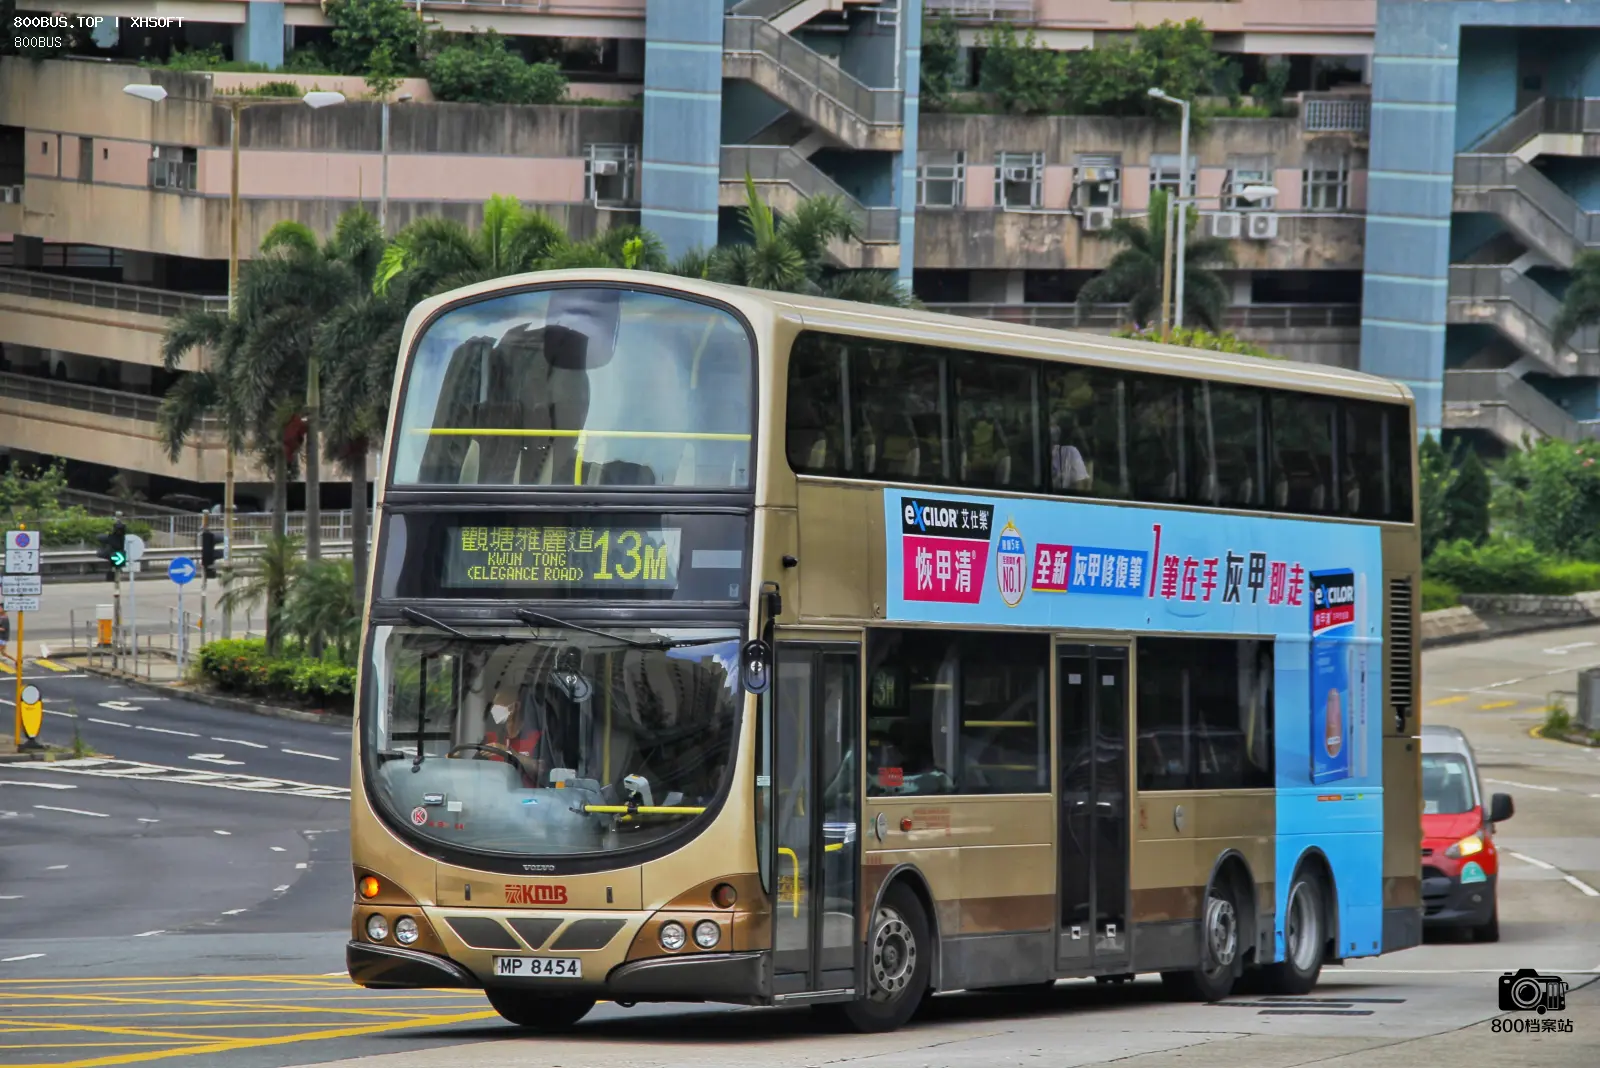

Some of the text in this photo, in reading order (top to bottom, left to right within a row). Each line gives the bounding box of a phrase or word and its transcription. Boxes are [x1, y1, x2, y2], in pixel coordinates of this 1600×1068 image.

[461, 527, 668, 580] 觀塘雅麗道 13M
[488, 552, 567, 566] KWUN TONG
[467, 567, 584, 581] (ELEGANCE ROAD)
[1036, 550, 1068, 585] 全新
[521, 885, 568, 904] KMB
[500, 958, 578, 976] MP 8454
